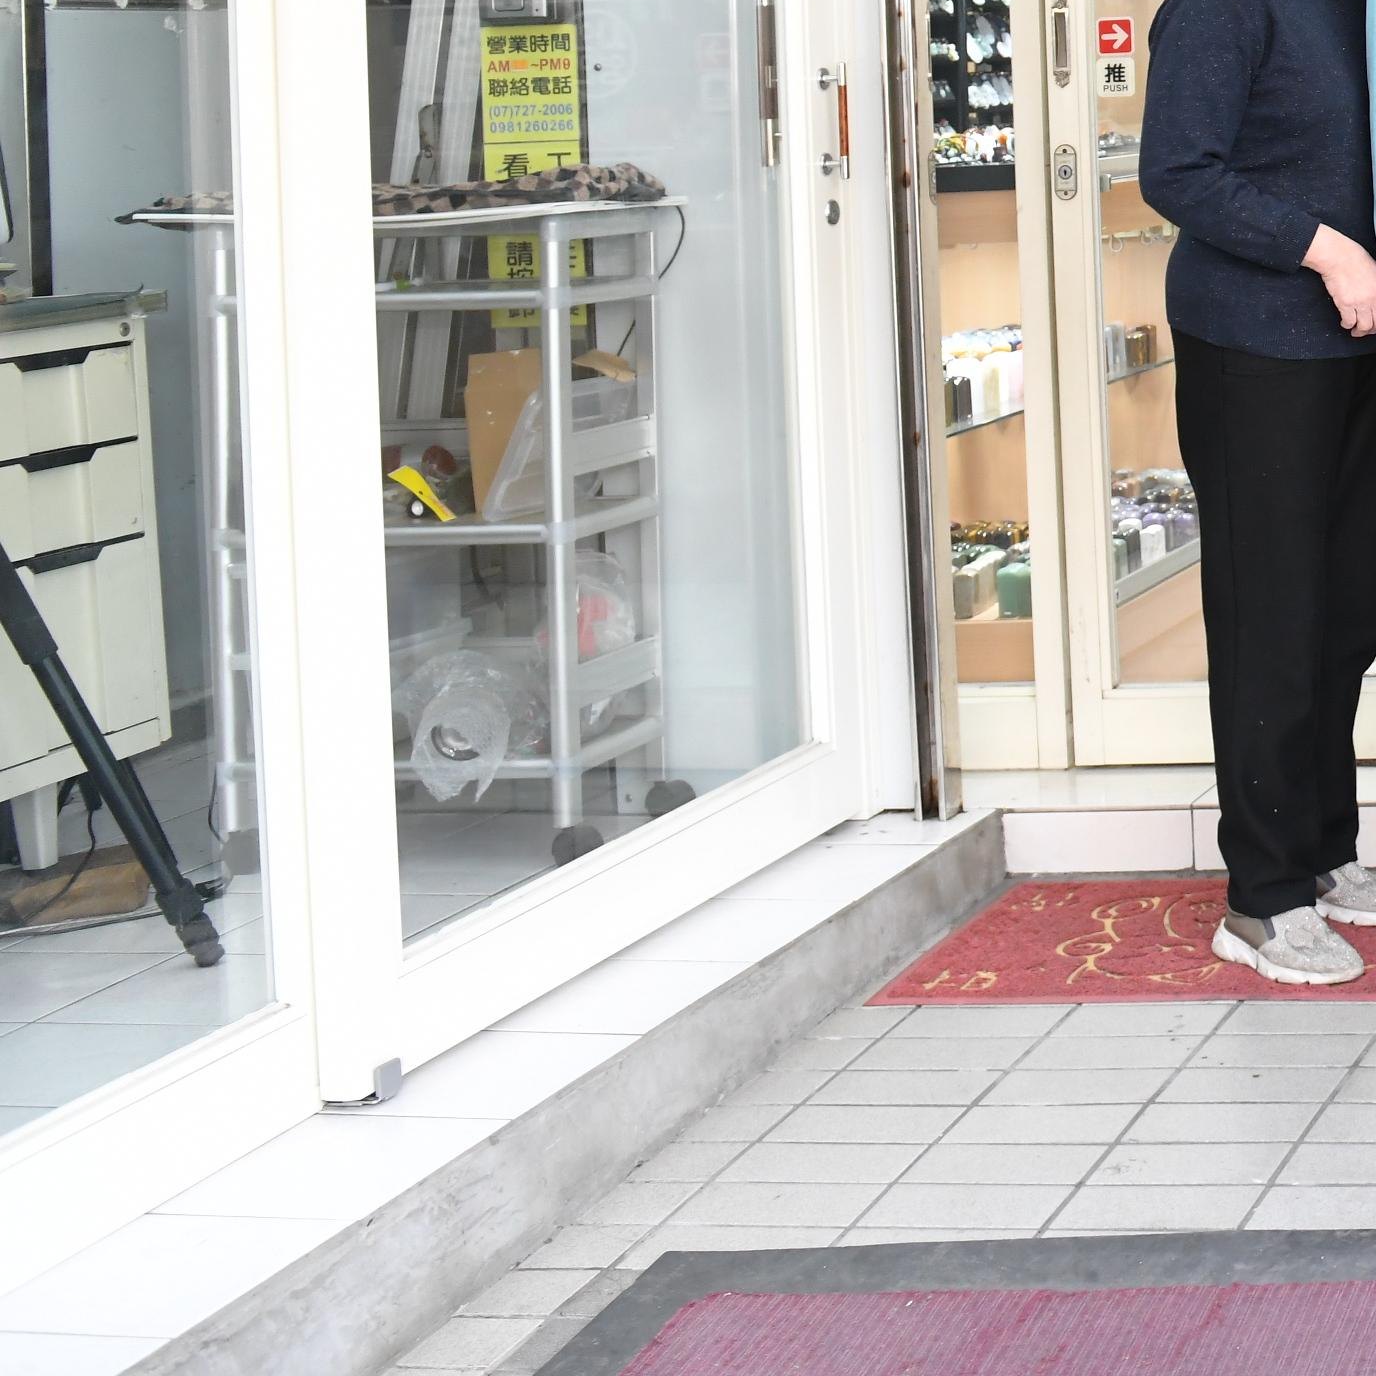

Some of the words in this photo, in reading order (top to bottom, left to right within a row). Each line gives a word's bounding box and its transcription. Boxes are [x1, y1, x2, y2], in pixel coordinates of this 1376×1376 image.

[487, 33, 570, 55] 營業時間
[1104, 63, 1126, 83] 推
[488, 76, 572, 98] 聯絡電話
[1103, 84, 1129, 92] PUSH
[489, 103, 573, 119] (07)727-2006
